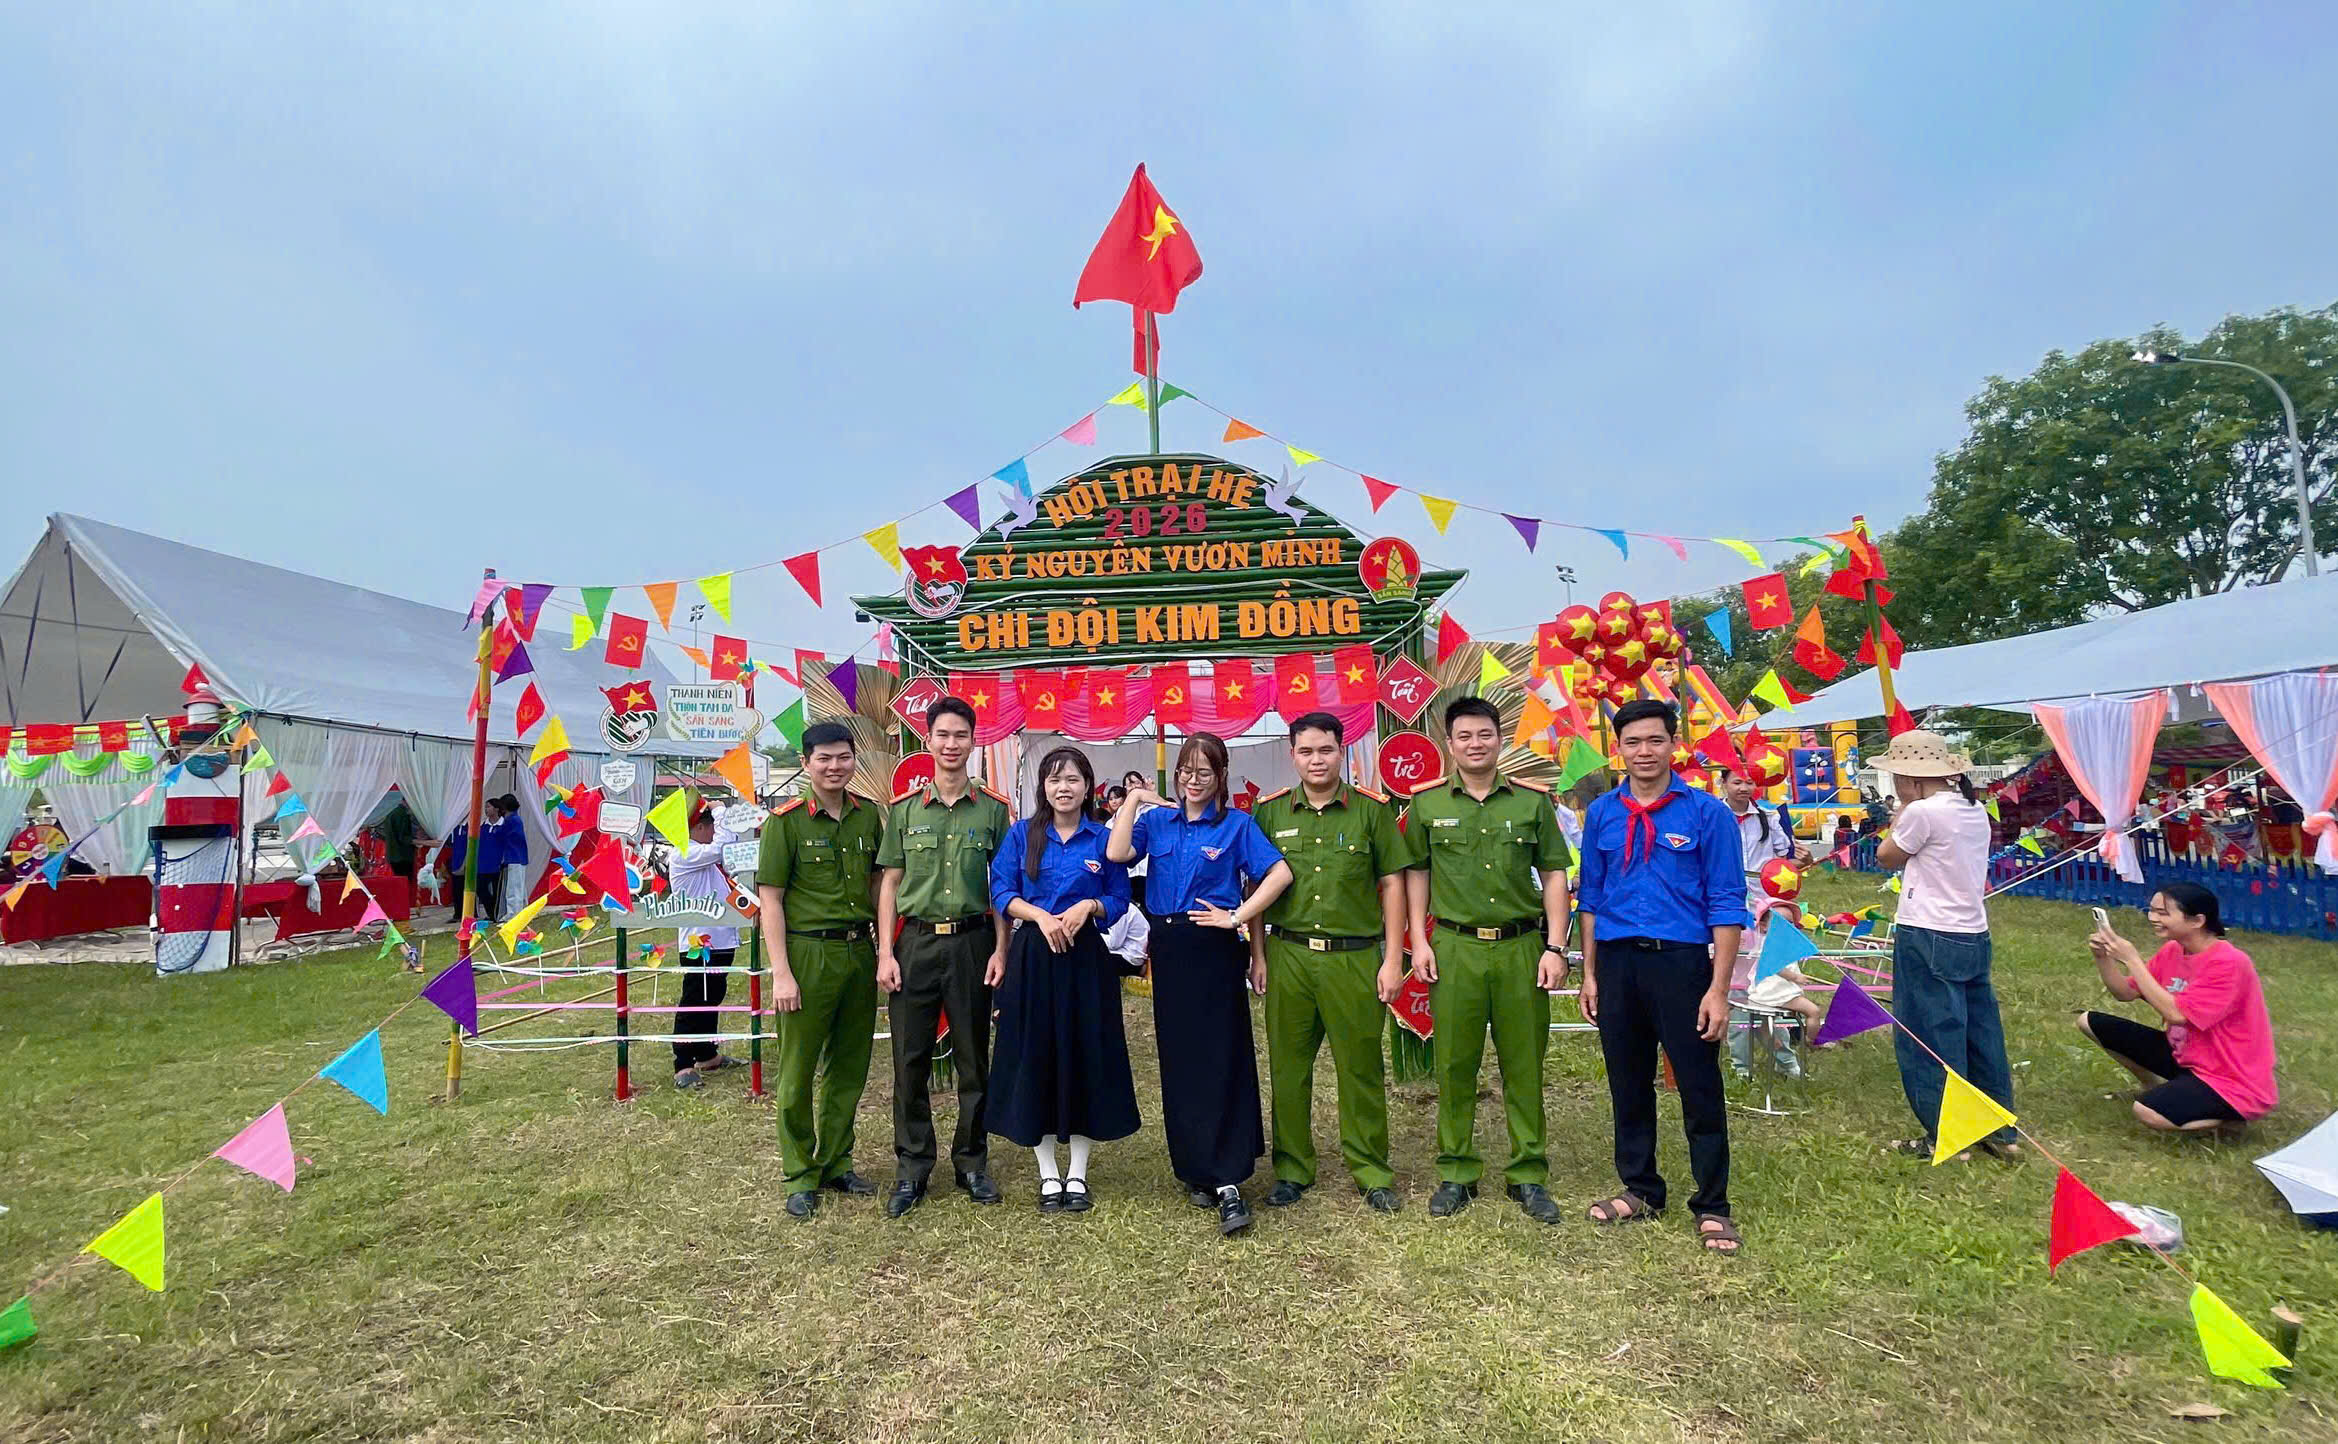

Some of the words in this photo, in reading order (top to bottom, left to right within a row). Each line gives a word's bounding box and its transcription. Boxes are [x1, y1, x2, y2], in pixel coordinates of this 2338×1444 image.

[1043, 477, 1108, 529] HỘI
[1109, 463, 1203, 502] TRẠI
[1207, 469, 1257, 510] HÈ
[1104, 503, 1207, 539] 2026
[975, 543, 1016, 581] KỶ
[1026, 538, 1152, 579] NGUYÊN
[1161, 540, 1250, 572] VƯƠN
[958, 611, 1030, 651] CHI
[1047, 597, 1120, 654] ĐỘI
[1135, 603, 1220, 643] KIM
[1237, 579, 1361, 638] ĐỒNG
[670, 688, 703, 698] THANH
[642, 888, 724, 919] Photobooth
